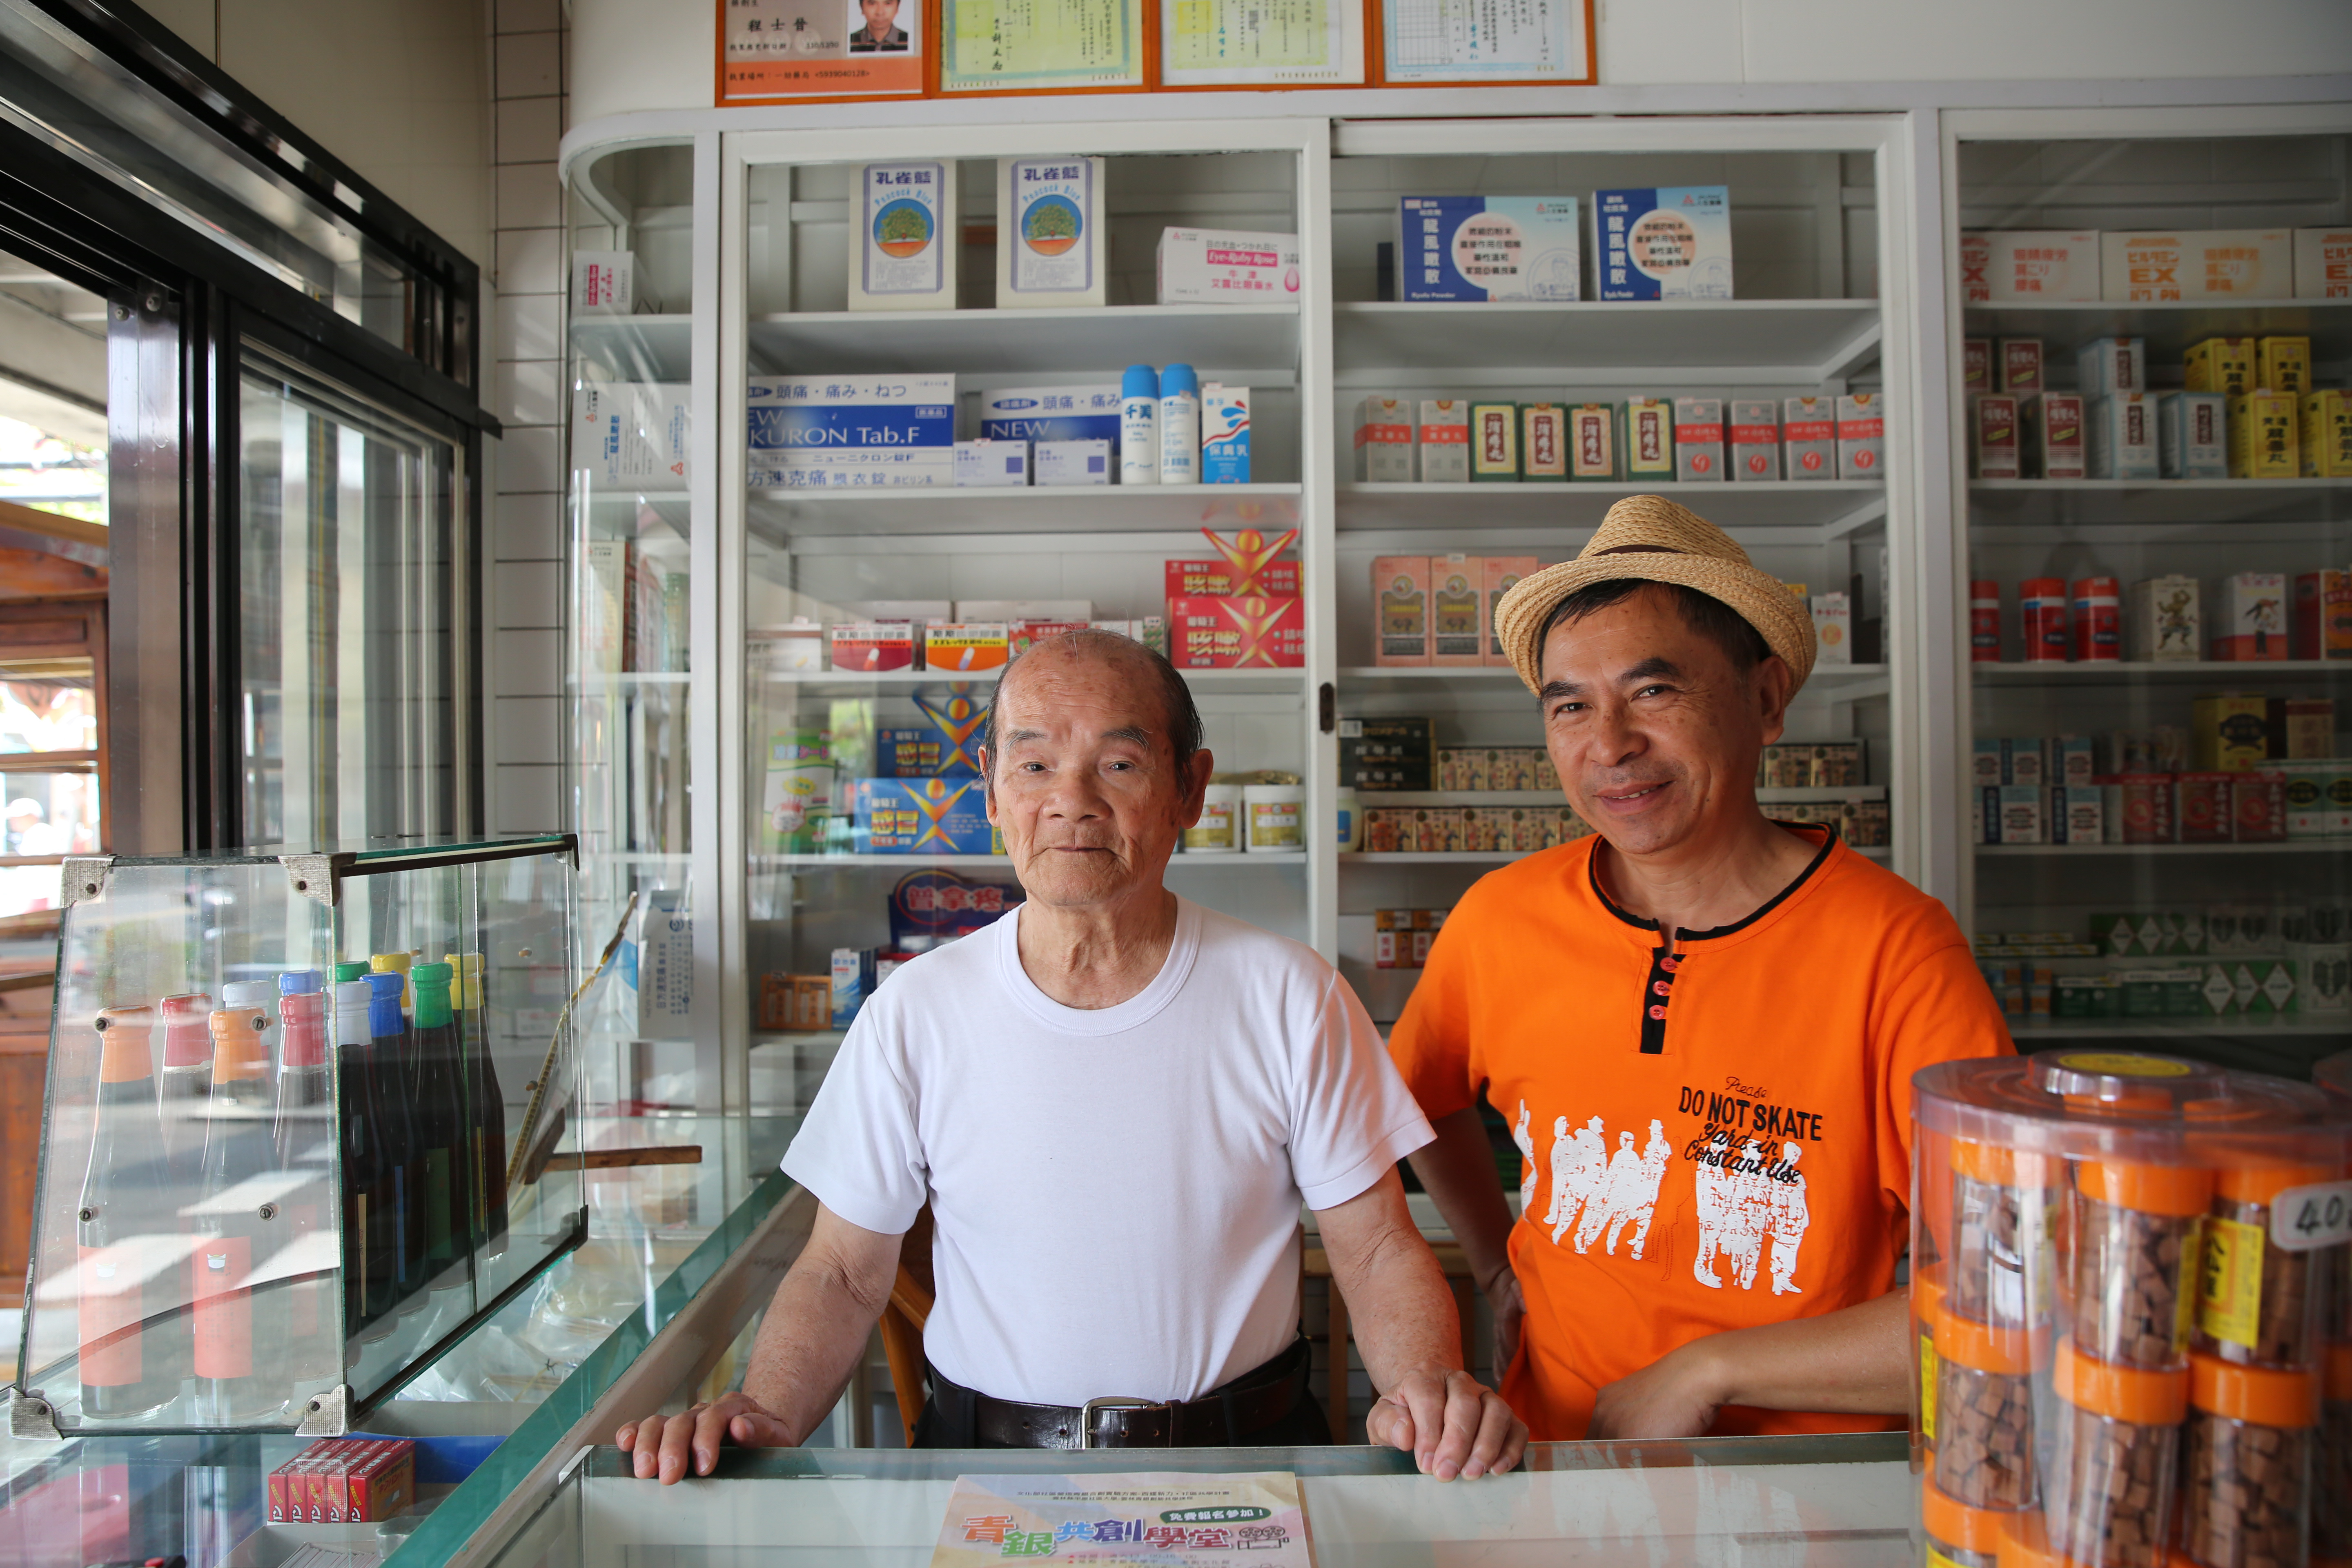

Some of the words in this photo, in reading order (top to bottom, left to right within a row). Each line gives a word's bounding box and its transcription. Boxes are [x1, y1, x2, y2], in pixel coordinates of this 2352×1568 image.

[874, 187, 911, 207] Peacock
[916, 189, 933, 206] Blue
[1022, 183, 1058, 203] Peacock
[1064, 184, 1081, 203] Blue
[2129, 267, 2177, 283] EX
[2325, 265, 2352, 280] E
[777, 383, 907, 400] 頭痛・痛み・ねつ
[751, 427, 848, 446] KURON
[856, 425, 920, 445] Tab.F
[991, 420, 1052, 439] NEW
[907, 885, 1004, 912] 普拿疼
[1725, 1076, 1767, 1098] Please
[1679, 1086, 1705, 1117] DO
[1707, 1091, 1751, 1128] NOT
[1753, 1103, 1823, 1142] SKATE
[1699, 1122, 1754, 1151] Yard
[1752, 1134, 1779, 1156] in
[1684, 1139, 1768, 1176] Constant
[1766, 1158, 1802, 1184] Use
[2296, 1195, 2352, 1236] 40
[1169, 1508, 1264, 1522] 免費報名參加！
[961, 1515, 1232, 1557] 青銀共創學堂
